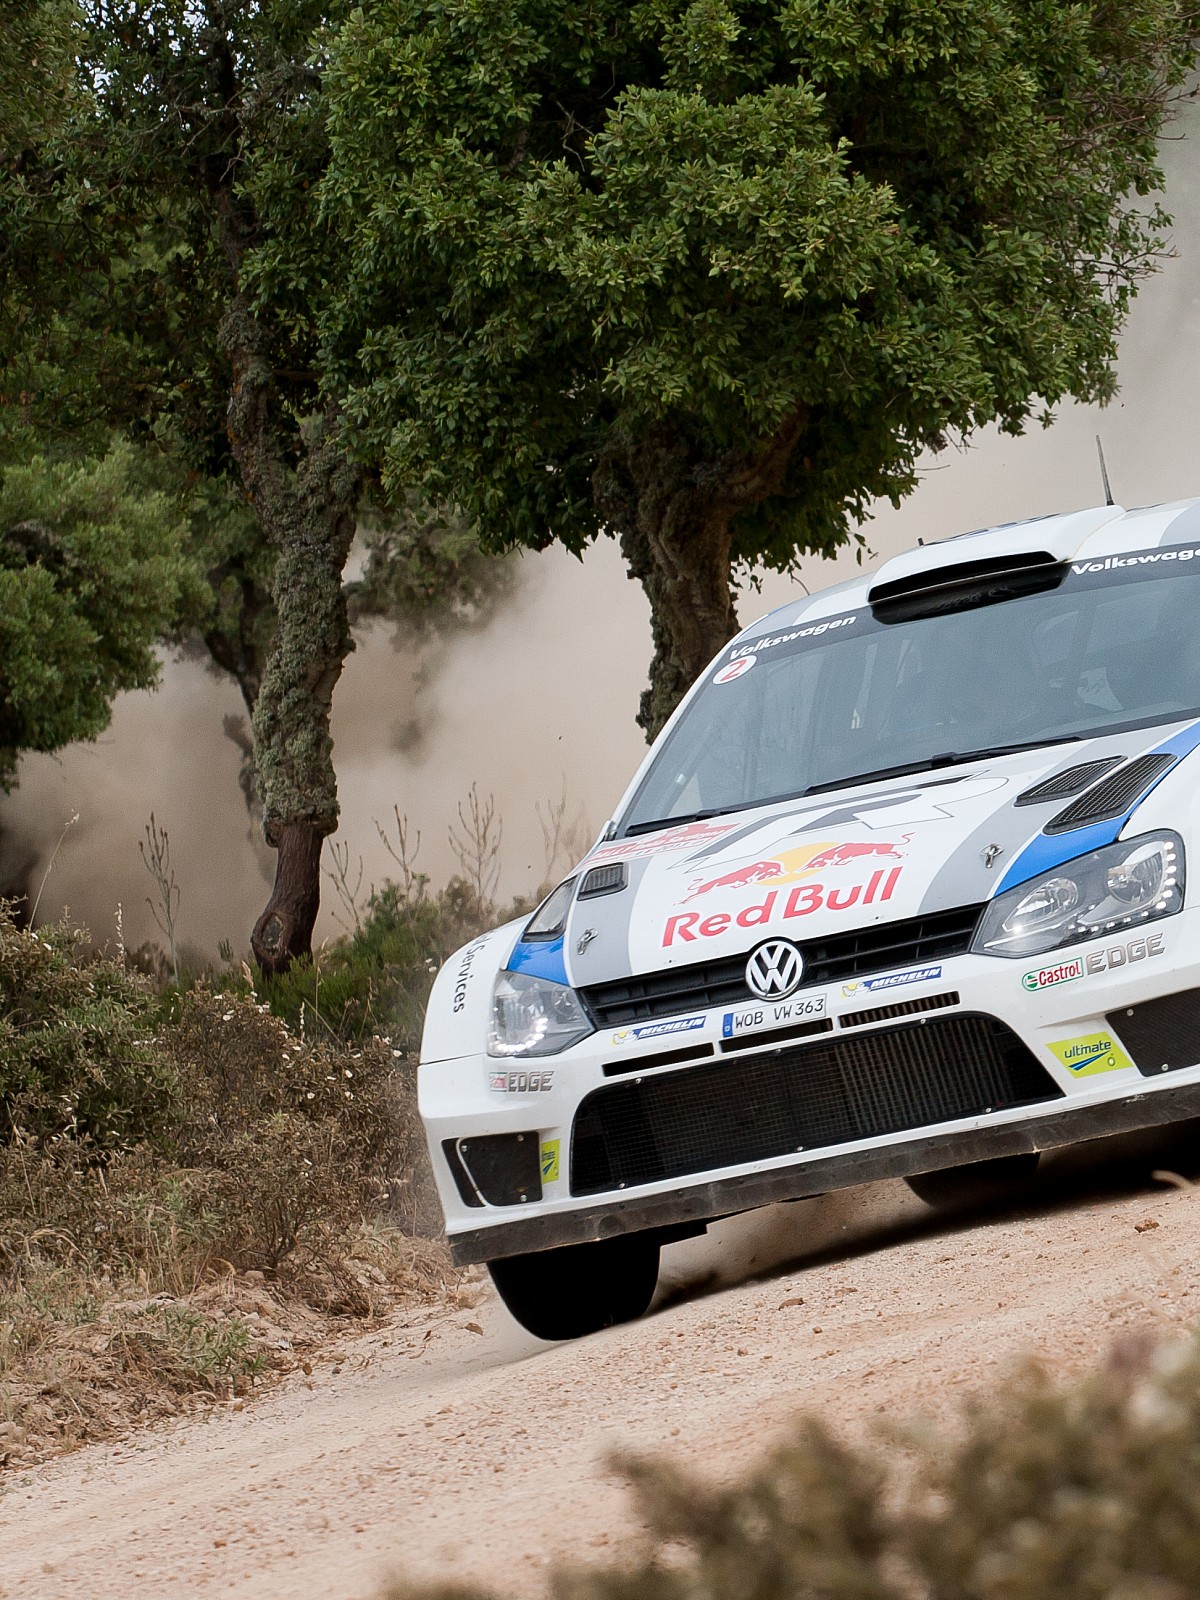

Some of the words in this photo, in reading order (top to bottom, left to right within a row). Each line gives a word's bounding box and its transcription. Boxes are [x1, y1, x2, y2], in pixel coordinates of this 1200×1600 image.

[729, 616, 857, 660] Volkswagen
[719, 659, 747, 682] 2
[662, 891, 779, 948] Red
[783, 866, 903, 919] Bull
[1038, 961, 1081, 986] Castrol
[1086, 933, 1166, 975] EDGE
[453, 944, 486, 1013] Services
[871, 966, 942, 989] MICHELIN
[639, 1017, 705, 1037] MICHELIN
[735, 1011, 764, 1029] WOB
[774, 1004, 794, 1021] VW
[795, 999, 824, 1016] 363
[1064, 1040, 1111, 1058] ultimate
[508, 1071, 555, 1092] EDGE
